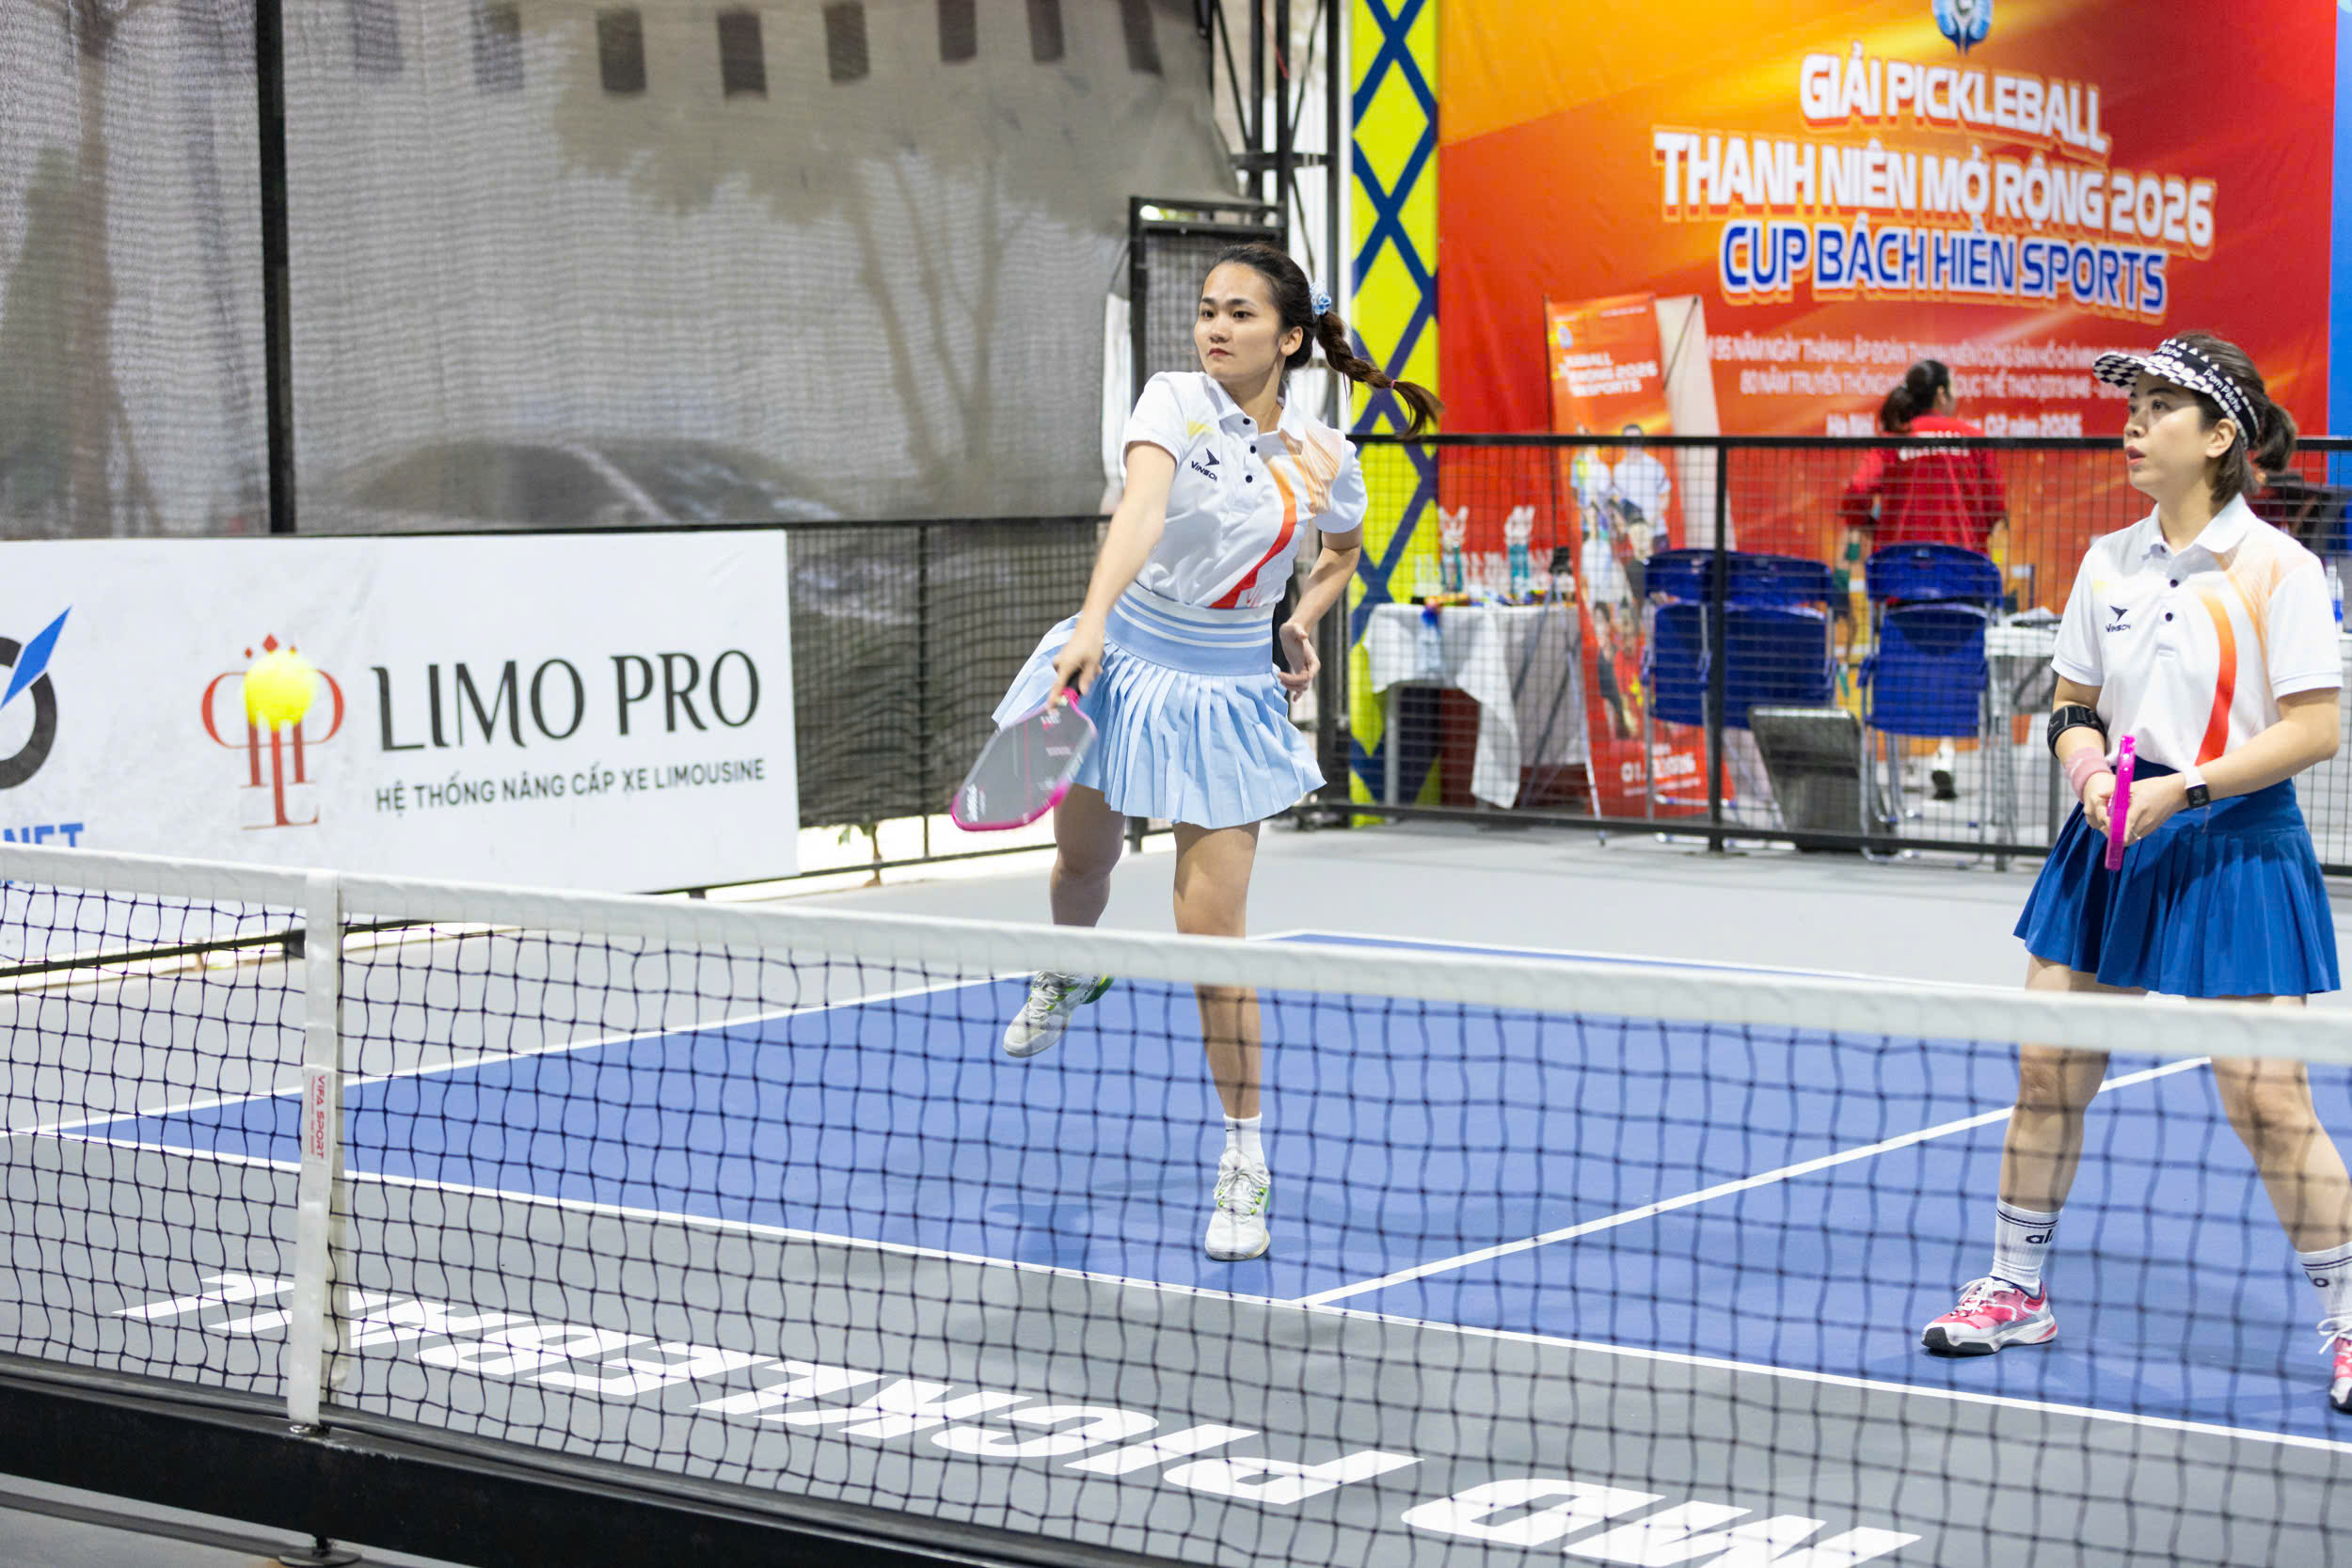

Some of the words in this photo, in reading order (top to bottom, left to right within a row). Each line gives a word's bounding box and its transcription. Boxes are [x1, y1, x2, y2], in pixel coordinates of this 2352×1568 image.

[1800, 40, 1882, 122] GIẢI
[1885, 59, 2110, 155] PICKLEBALL
[1653, 131, 1816, 208] THANH
[1820, 137, 1916, 212] NIÊN
[2111, 173, 2214, 248] 2026
[1723, 223, 1809, 291] CUP
[1817, 212, 1927, 287] BÁCH
[2021, 239, 2165, 311] SPORTS
[371, 657, 584, 752] LIMO
[609, 649, 760, 736] PRO
[376, 783, 405, 816] HỆ
[414, 770, 496, 808] THỐNG
[502, 770, 565, 802] NÂNG
[571, 760, 616, 796] CẤP
[622, 768, 649, 793] XE
[653, 757, 766, 790] LIMOUSINE
[316, 1075, 326, 1106] VIFA
[316, 1110, 326, 1160] SPORT
[2026, 1228, 2054, 1243] al
[1401, 1478, 1922, 1568] MD
